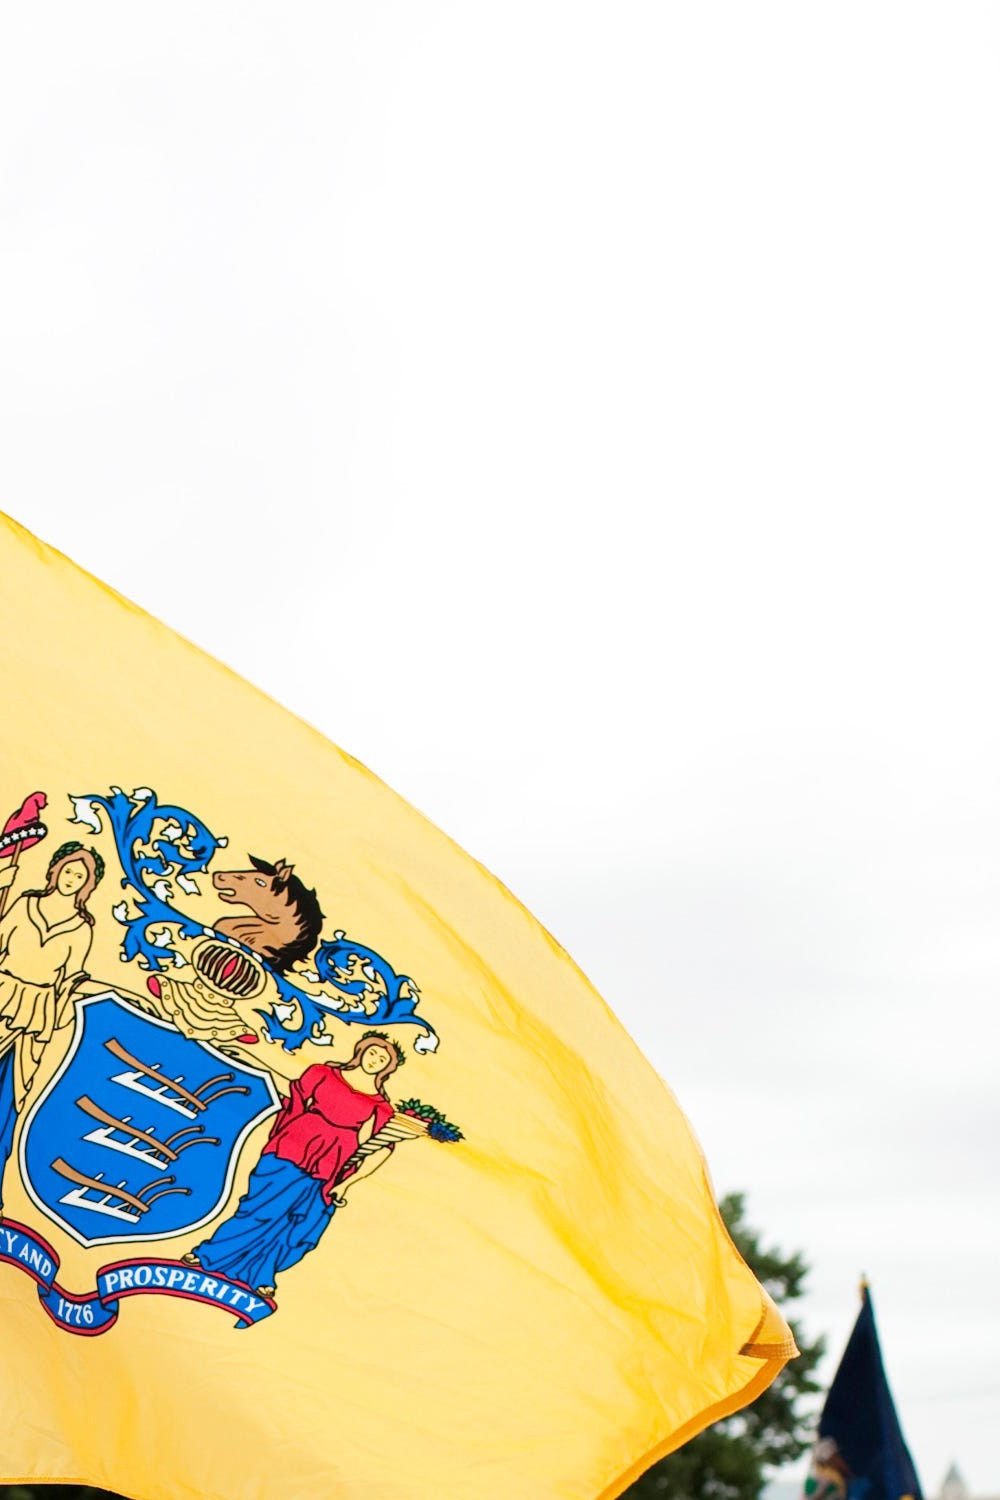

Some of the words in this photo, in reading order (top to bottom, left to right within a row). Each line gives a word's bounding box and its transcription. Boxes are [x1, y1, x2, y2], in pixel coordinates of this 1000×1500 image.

[18, 1242, 52, 1278] AND
[104, 1265, 266, 1314] PROSPERITY
[56, 1298, 95, 1325] 1776
